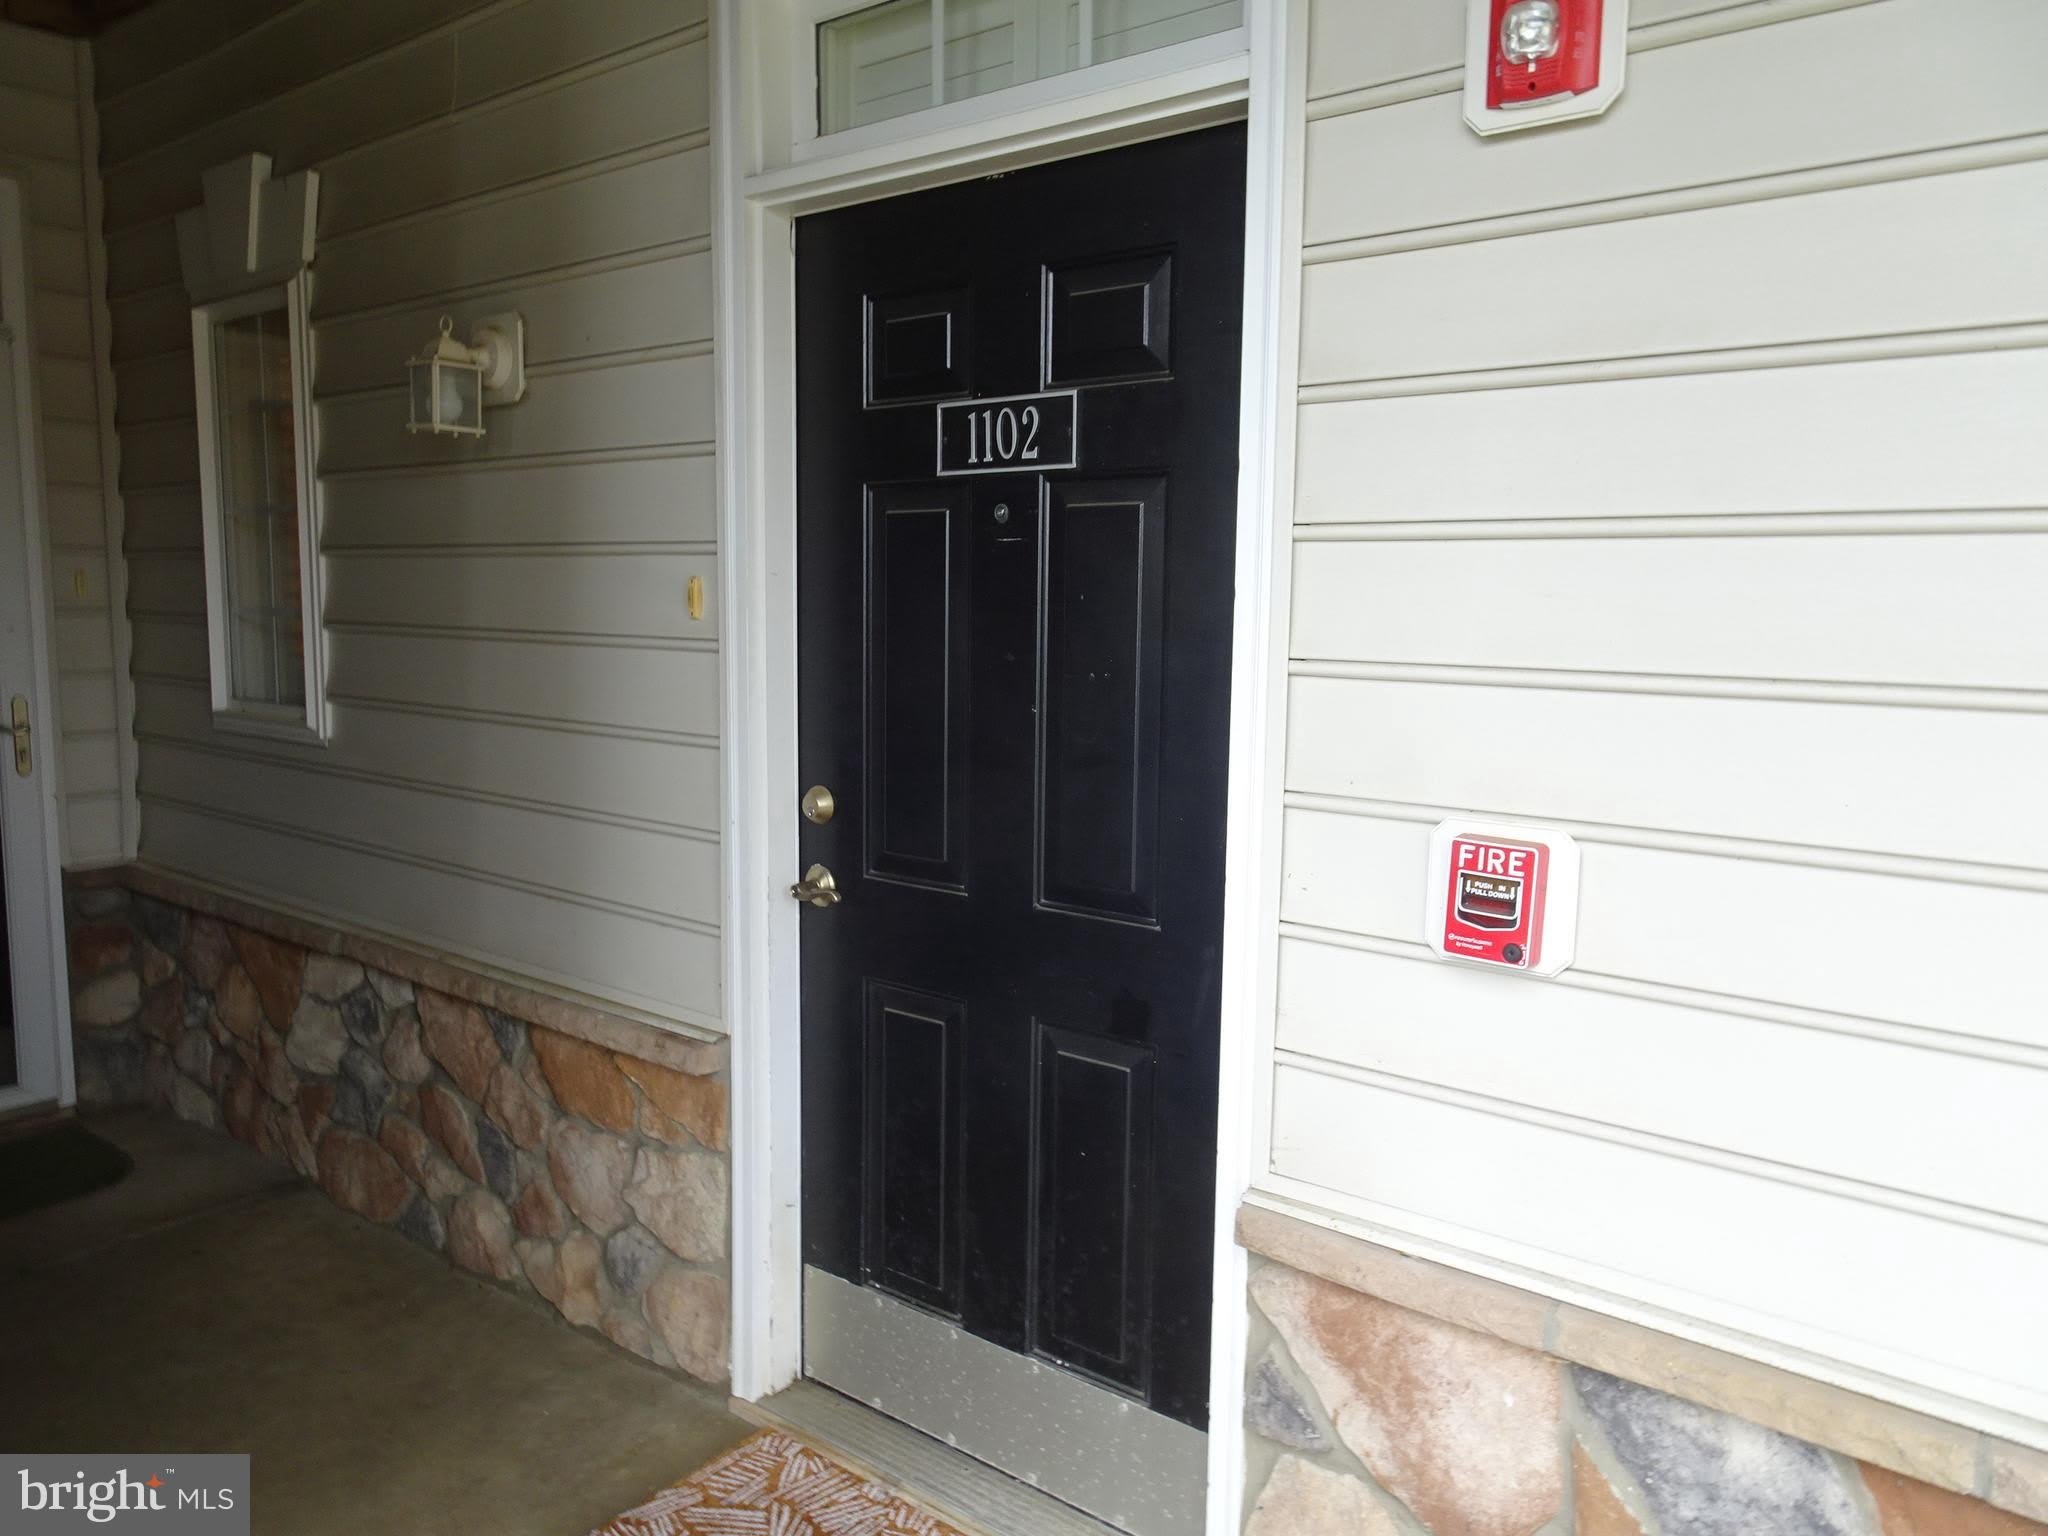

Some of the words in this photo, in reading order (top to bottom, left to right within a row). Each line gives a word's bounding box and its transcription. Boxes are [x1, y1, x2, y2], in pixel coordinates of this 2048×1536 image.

[967, 405, 1040, 464] 1102
[1458, 843, 1527, 877] FIRE
[1474, 881, 1494, 890] PUSH
